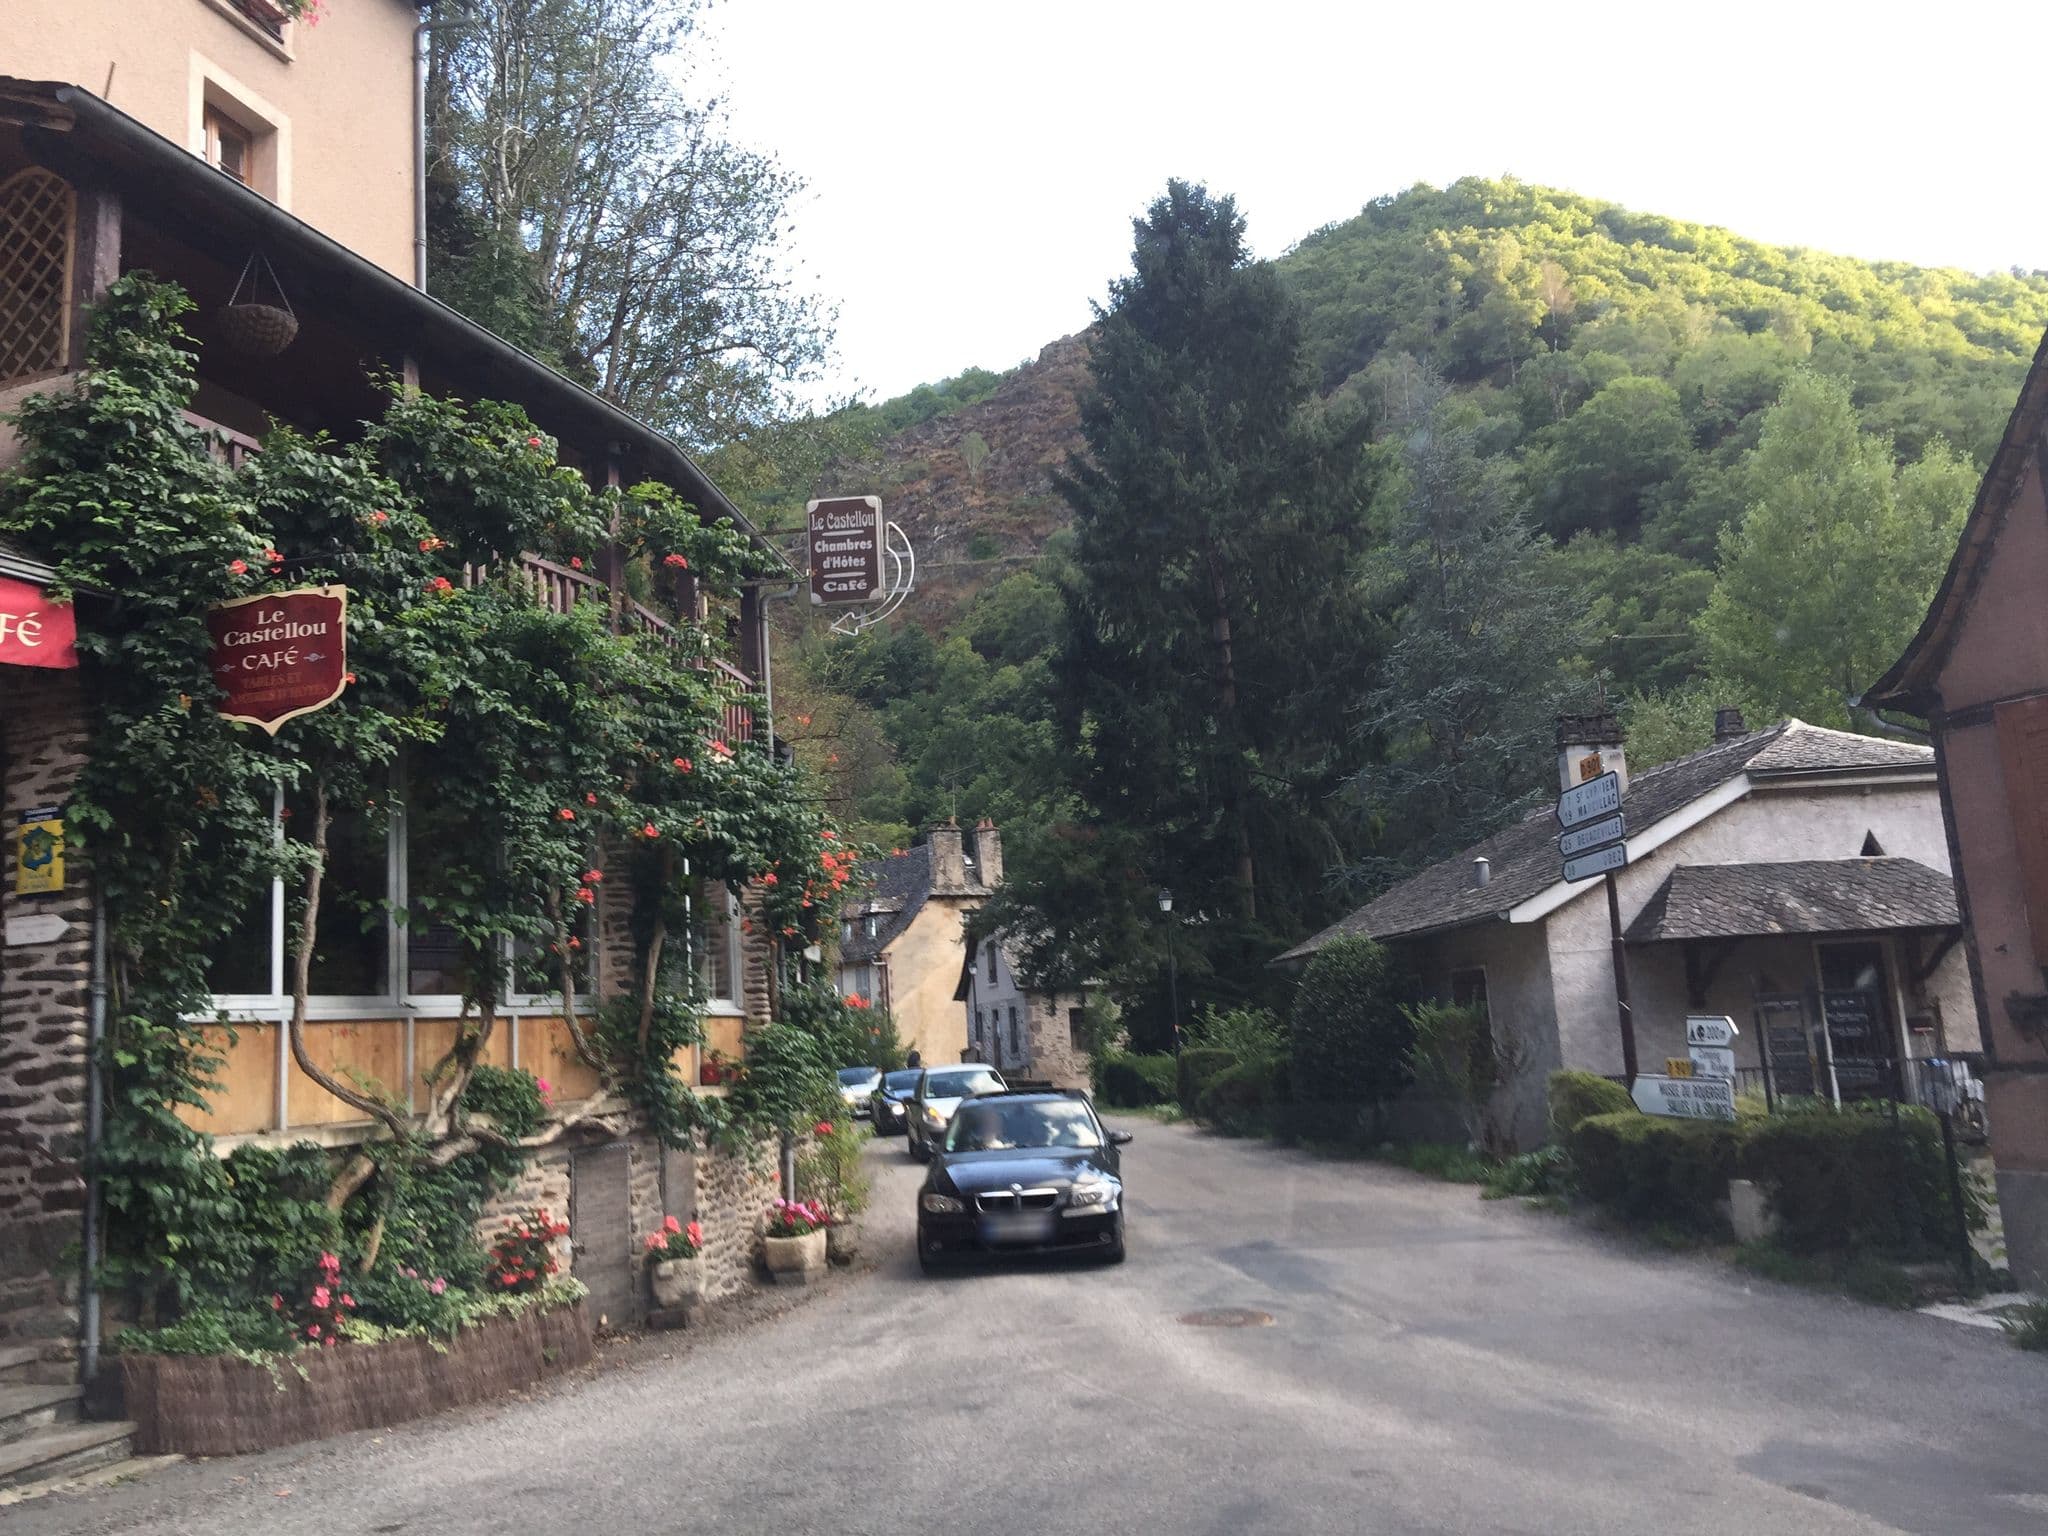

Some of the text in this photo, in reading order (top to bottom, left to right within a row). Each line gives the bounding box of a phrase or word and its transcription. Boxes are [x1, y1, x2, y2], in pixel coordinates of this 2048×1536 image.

[811, 510, 875, 531] Le Castellou
[814, 538, 873, 553] Chambres
[822, 579, 868, 592] Café
[258, 610, 285, 625] Le
[223, 622, 327, 647] Castellou
[242, 645, 299, 671] CAFÉ
